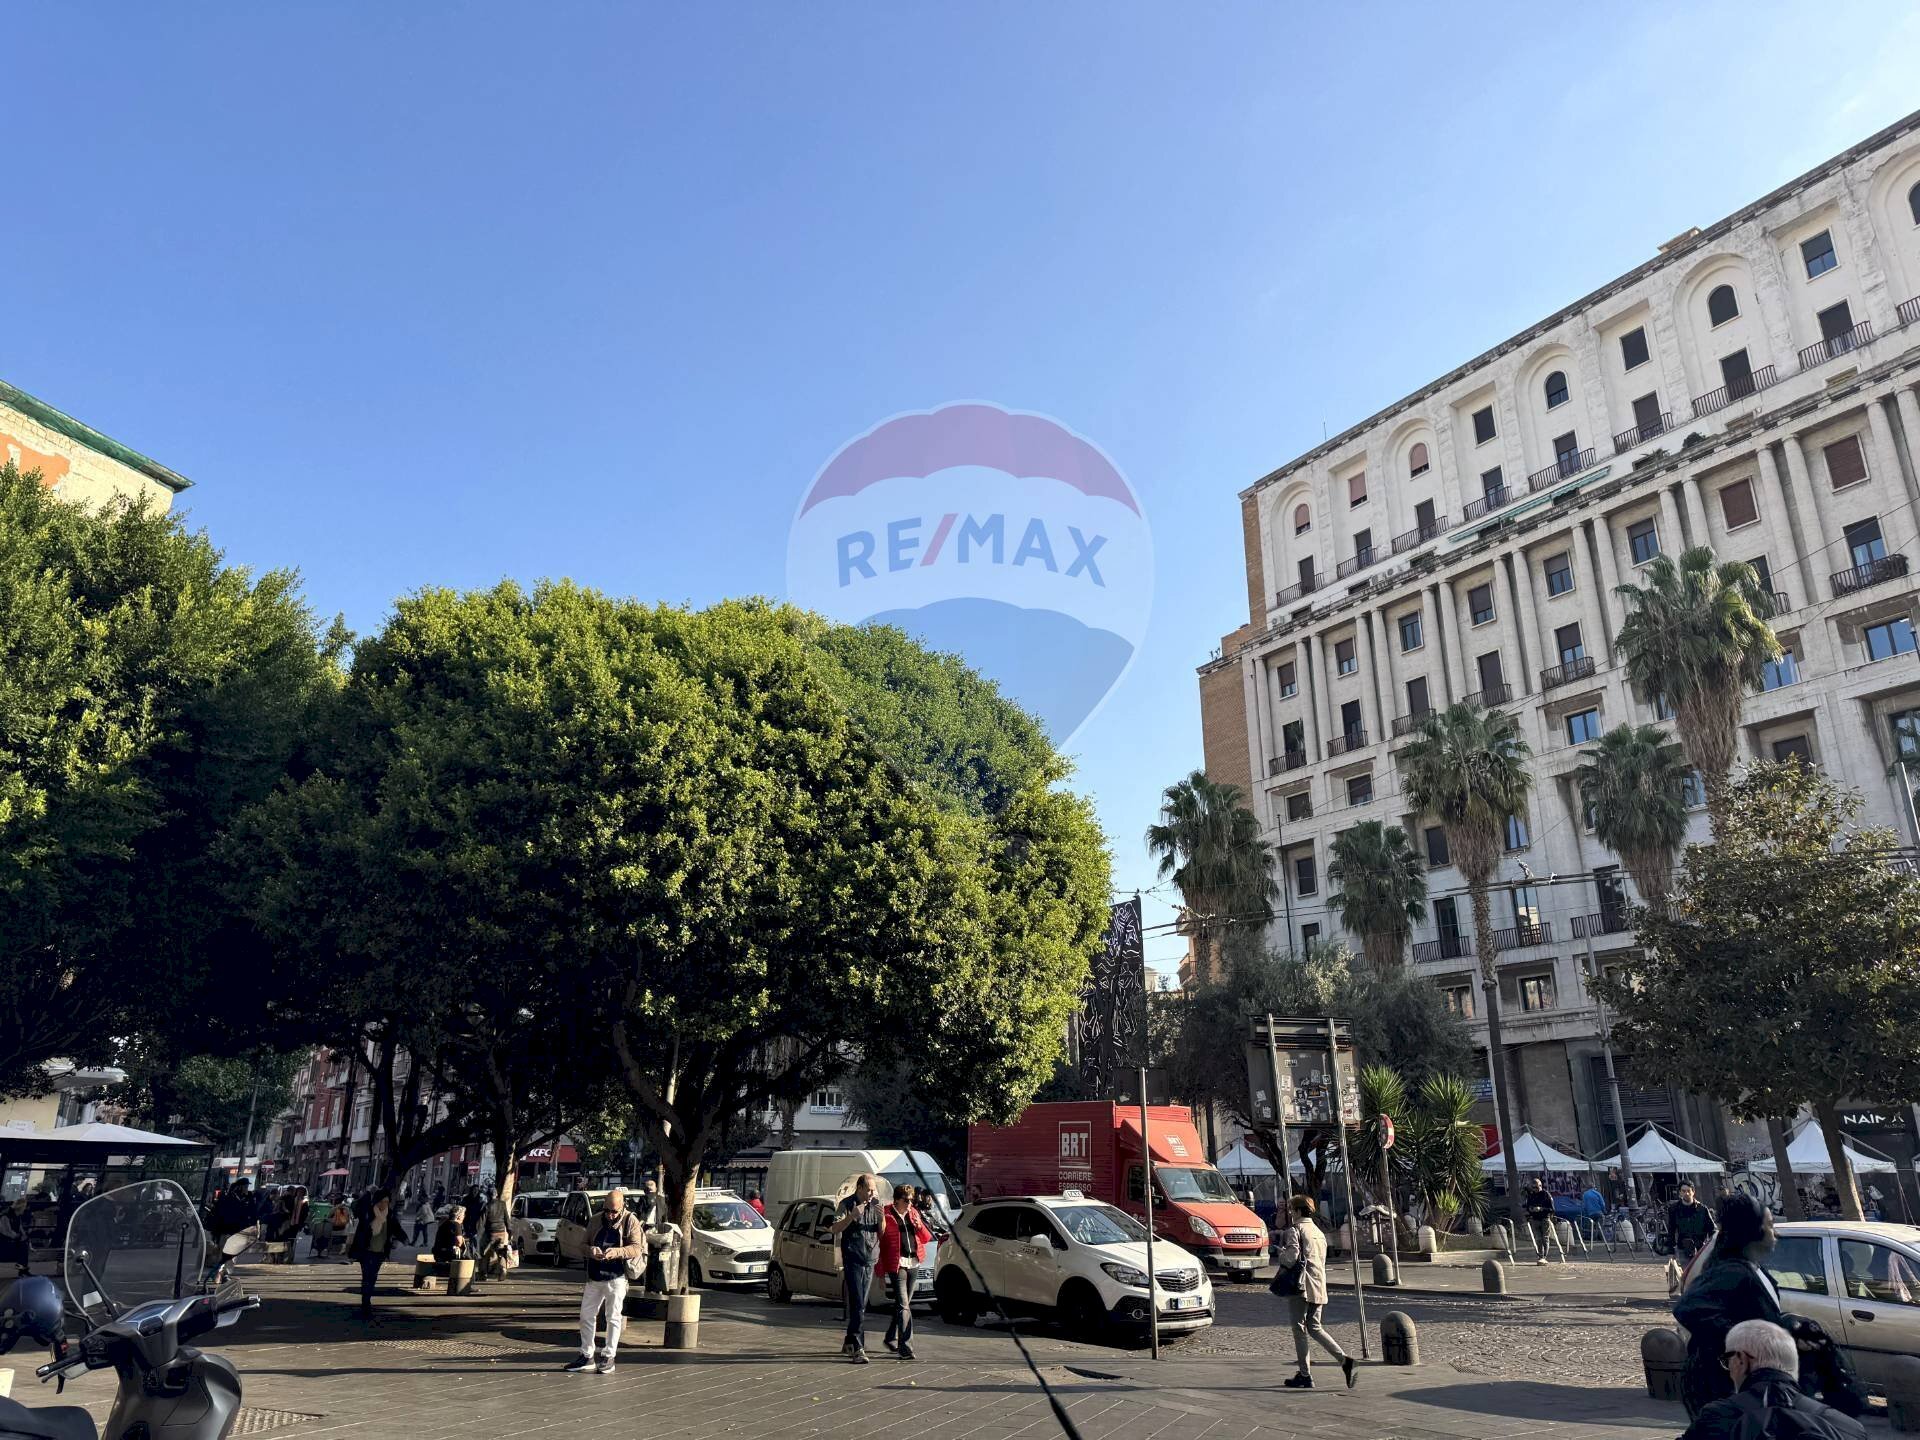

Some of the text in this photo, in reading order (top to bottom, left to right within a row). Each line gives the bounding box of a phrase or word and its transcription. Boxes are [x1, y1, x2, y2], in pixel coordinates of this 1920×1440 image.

[1061, 1132, 1089, 1157] BRT
[528, 1148, 552, 1157] KFC
[1058, 1171, 1093, 1181] CORRIERE
[1058, 1182, 1092, 1192] ESPRESSO
